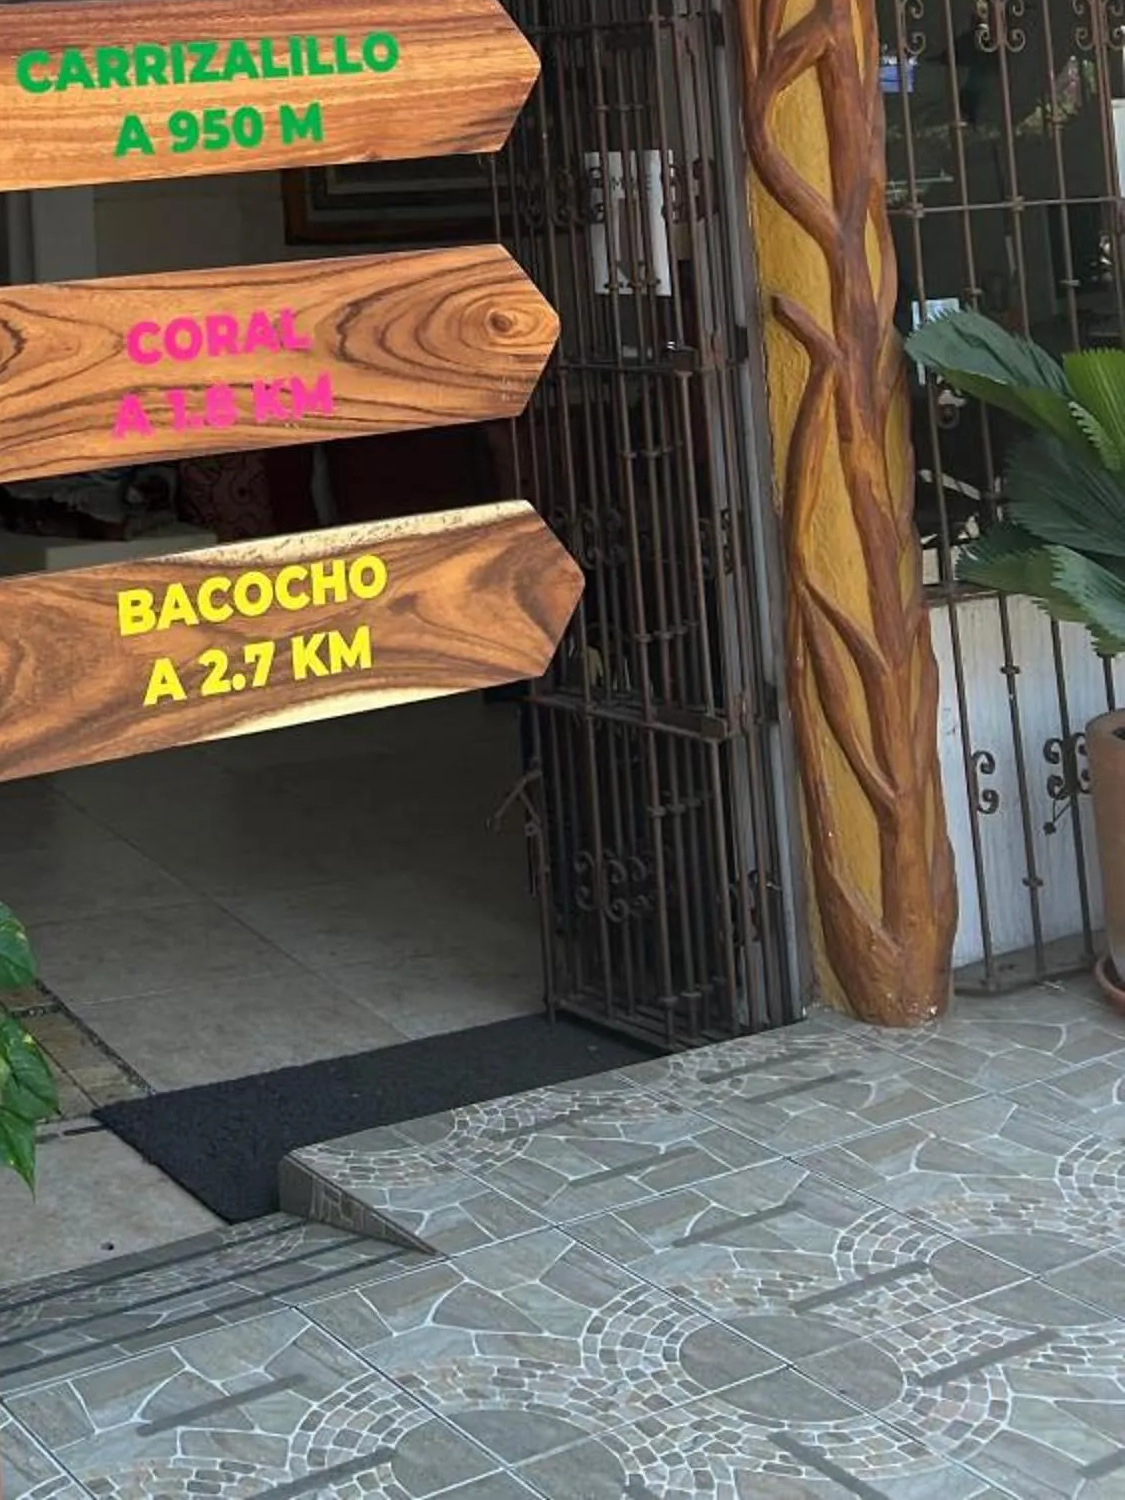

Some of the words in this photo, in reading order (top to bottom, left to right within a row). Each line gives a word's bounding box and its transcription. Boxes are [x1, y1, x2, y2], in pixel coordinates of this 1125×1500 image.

[17, 33, 398, 93] CARRIZALILLO
[116, 115, 152, 156] A
[169, 107, 263, 152] 950
[280, 104, 322, 143] M
[127, 309, 310, 364] CORAL
[114, 393, 152, 436] A
[168, 385, 238, 430] 1.8
[252, 374, 334, 421] KM
[117, 555, 388, 638] BACOCHO
[145, 659, 185, 701] A
[199, 641, 275, 695] 2.7
[291, 627, 372, 676] KM
